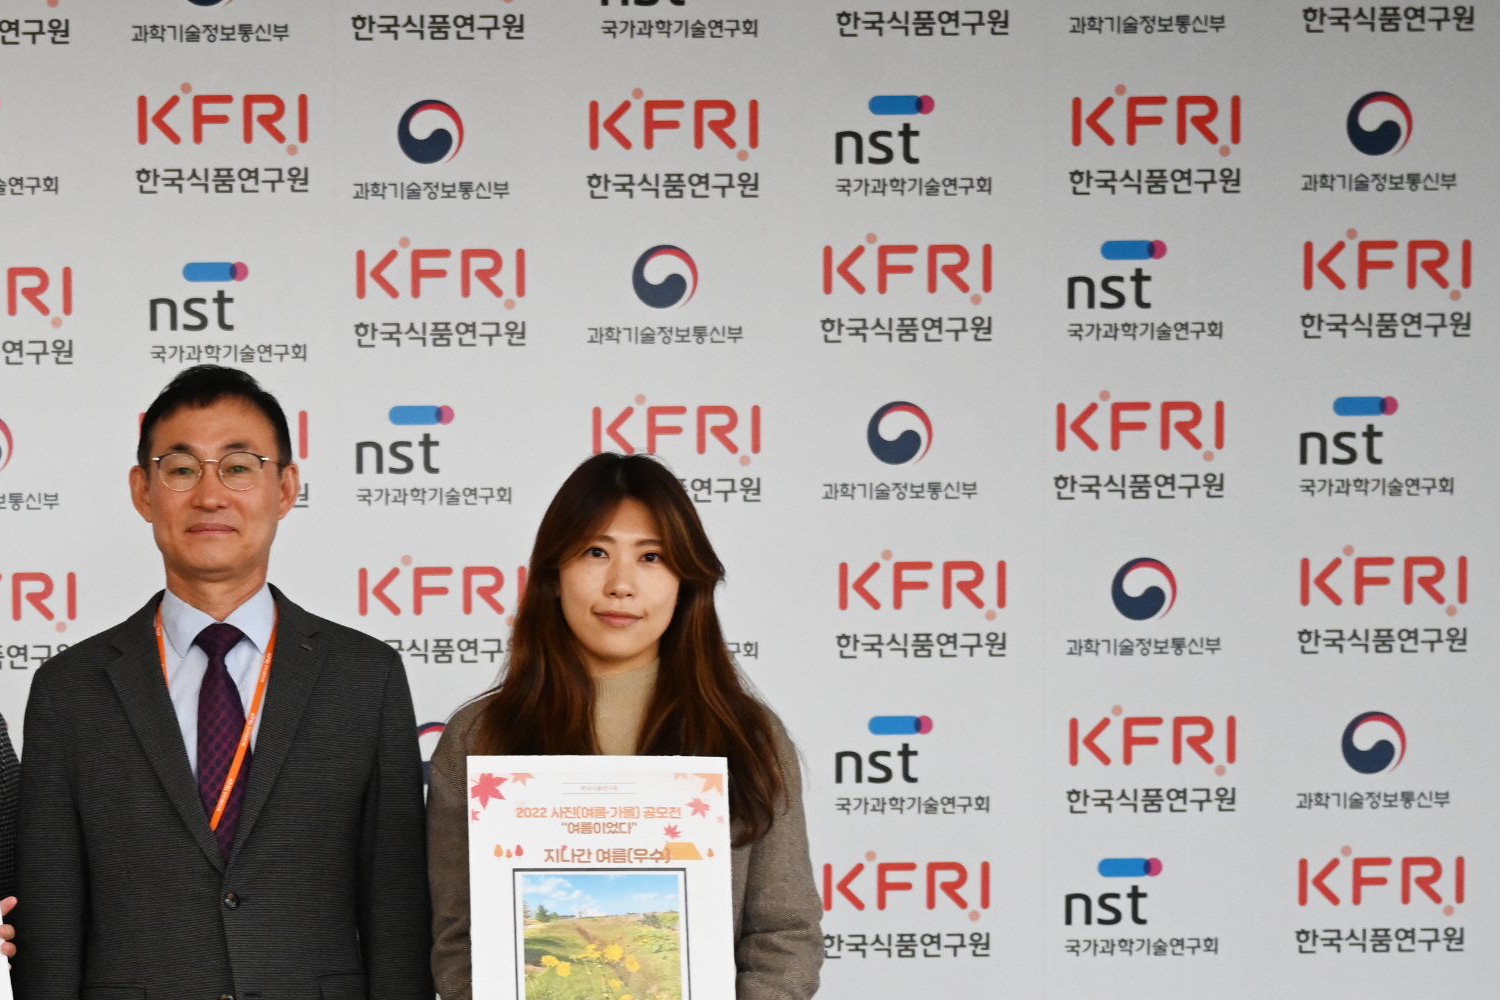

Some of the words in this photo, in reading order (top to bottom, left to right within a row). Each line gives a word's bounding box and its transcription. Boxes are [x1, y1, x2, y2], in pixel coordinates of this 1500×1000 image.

[352, 14, 524, 41] 한국식품연구원
[601, 19, 758, 38] 국가과학기술연구회
[837, 10, 1008, 37] 한국식품연구원
[1069, 15, 1225, 34] 과학기술정보통신부
[1303, 6, 1474, 33] 한국식품연구원
[132, 24, 289, 43] 과학기술정보통신부
[138, 94, 307, 144] KFRI
[590, 100, 758, 149] KFRI
[1073, 96, 1240, 146] KFRI
[836, 123, 919, 165] nst
[136, 167, 308, 194] 한국식품연구원
[353, 182, 509, 200] 과학기술정보통신부
[587, 173, 758, 199] 한국식품연구원
[836, 177, 992, 197] 국가과학기술연구회
[1069, 168, 1240, 195] 한국식품연구원
[1302, 173, 1456, 192] 과학기술정보통신부
[357, 249, 525, 298] KFRI
[824, 244, 992, 294] KFRI
[1305, 240, 1471, 289] KFRI
[1068, 268, 1151, 309] nst
[150, 290, 234, 331] nst
[354, 321, 525, 348] 한국식품연구원
[588, 326, 743, 344] 과학기술정보통신부
[821, 316, 992, 343] 한국식품연구원
[1068, 321, 1223, 341] 국가과학기술연구회
[1301, 312, 1471, 339] 한국식품연구원
[151, 344, 306, 363] 국가과학기술연구회
[1058, 402, 1224, 451] KFRI
[356, 433, 439, 474] nst
[1300, 424, 1383, 465] nst
[357, 487, 511, 506] 국가과학기술연구회
[823, 482, 977, 500] 과학기술정보통신부
[1054, 473, 1224, 500] 한국식품연구원
[1300, 477, 1454, 496] 국가과학기술연구회
[840, 561, 1006, 610] KFRI
[1302, 557, 1466, 605] KFRI
[836, 632, 1006, 659] 한국식품연구원
[1067, 637, 1221, 656] 과학기술정보통신부
[1297, 627, 1467, 654] 한국식품연구원
[1070, 716, 1235, 765] KFRI
[836, 743, 918, 783] nst
[515, 807, 548, 819] 2022
[643, 806, 682, 819] 공모전
[835, 796, 989, 815] 국가과학기술연구회
[1066, 787, 1235, 814] 한국식품연구원
[1296, 791, 1450, 809] 과학기술정보통신부
[544, 848, 592, 864] 지나간
[596, 848, 671, 864] 여름(우수)
[824, 862, 989, 910] KFRI
[1300, 857, 1464, 905] KFRI
[1065, 885, 1147, 925] nst
[822, 931, 990, 958] 한국식품연구원
[1065, 937, 1218, 956] 국가과학기술연구회
[1295, 927, 1464, 954] 한국식품연구원
